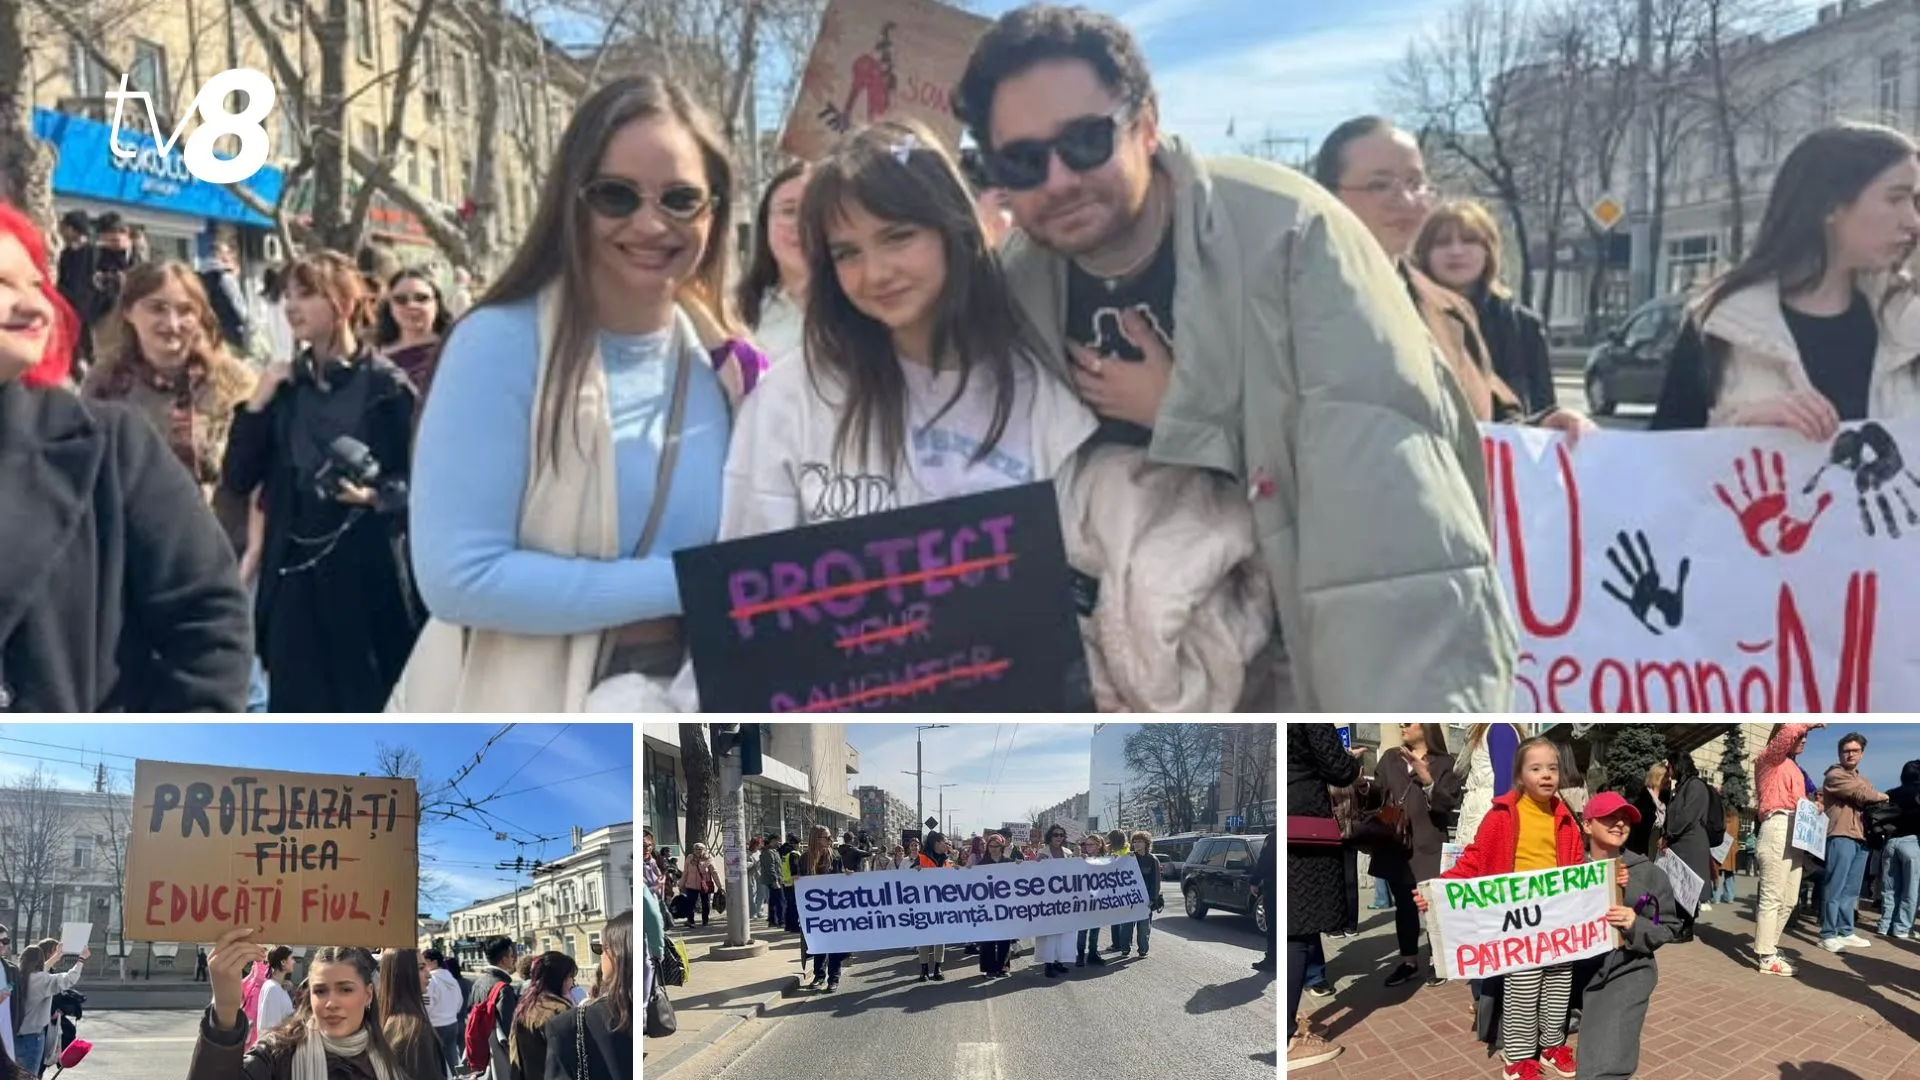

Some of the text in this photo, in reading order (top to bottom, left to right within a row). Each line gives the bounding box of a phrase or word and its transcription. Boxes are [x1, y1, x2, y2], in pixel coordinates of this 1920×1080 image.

[728, 515, 1015, 639] PROTECT
[834, 602, 932, 656] YOUR
[804, 868, 1138, 912] Statul la nevoie se cunoaște:
[1445, 862, 1609, 910] PARTENERIAT
[805, 911, 874, 934] Femei
[877, 910, 896, 929] în
[899, 904, 993, 930] siguranță.
[995, 899, 1071, 922] Dreptate
[1073, 895, 1087, 913] în
[1502, 903, 1542, 932] NU
[1456, 916, 1609, 977] PATRIARHAT
